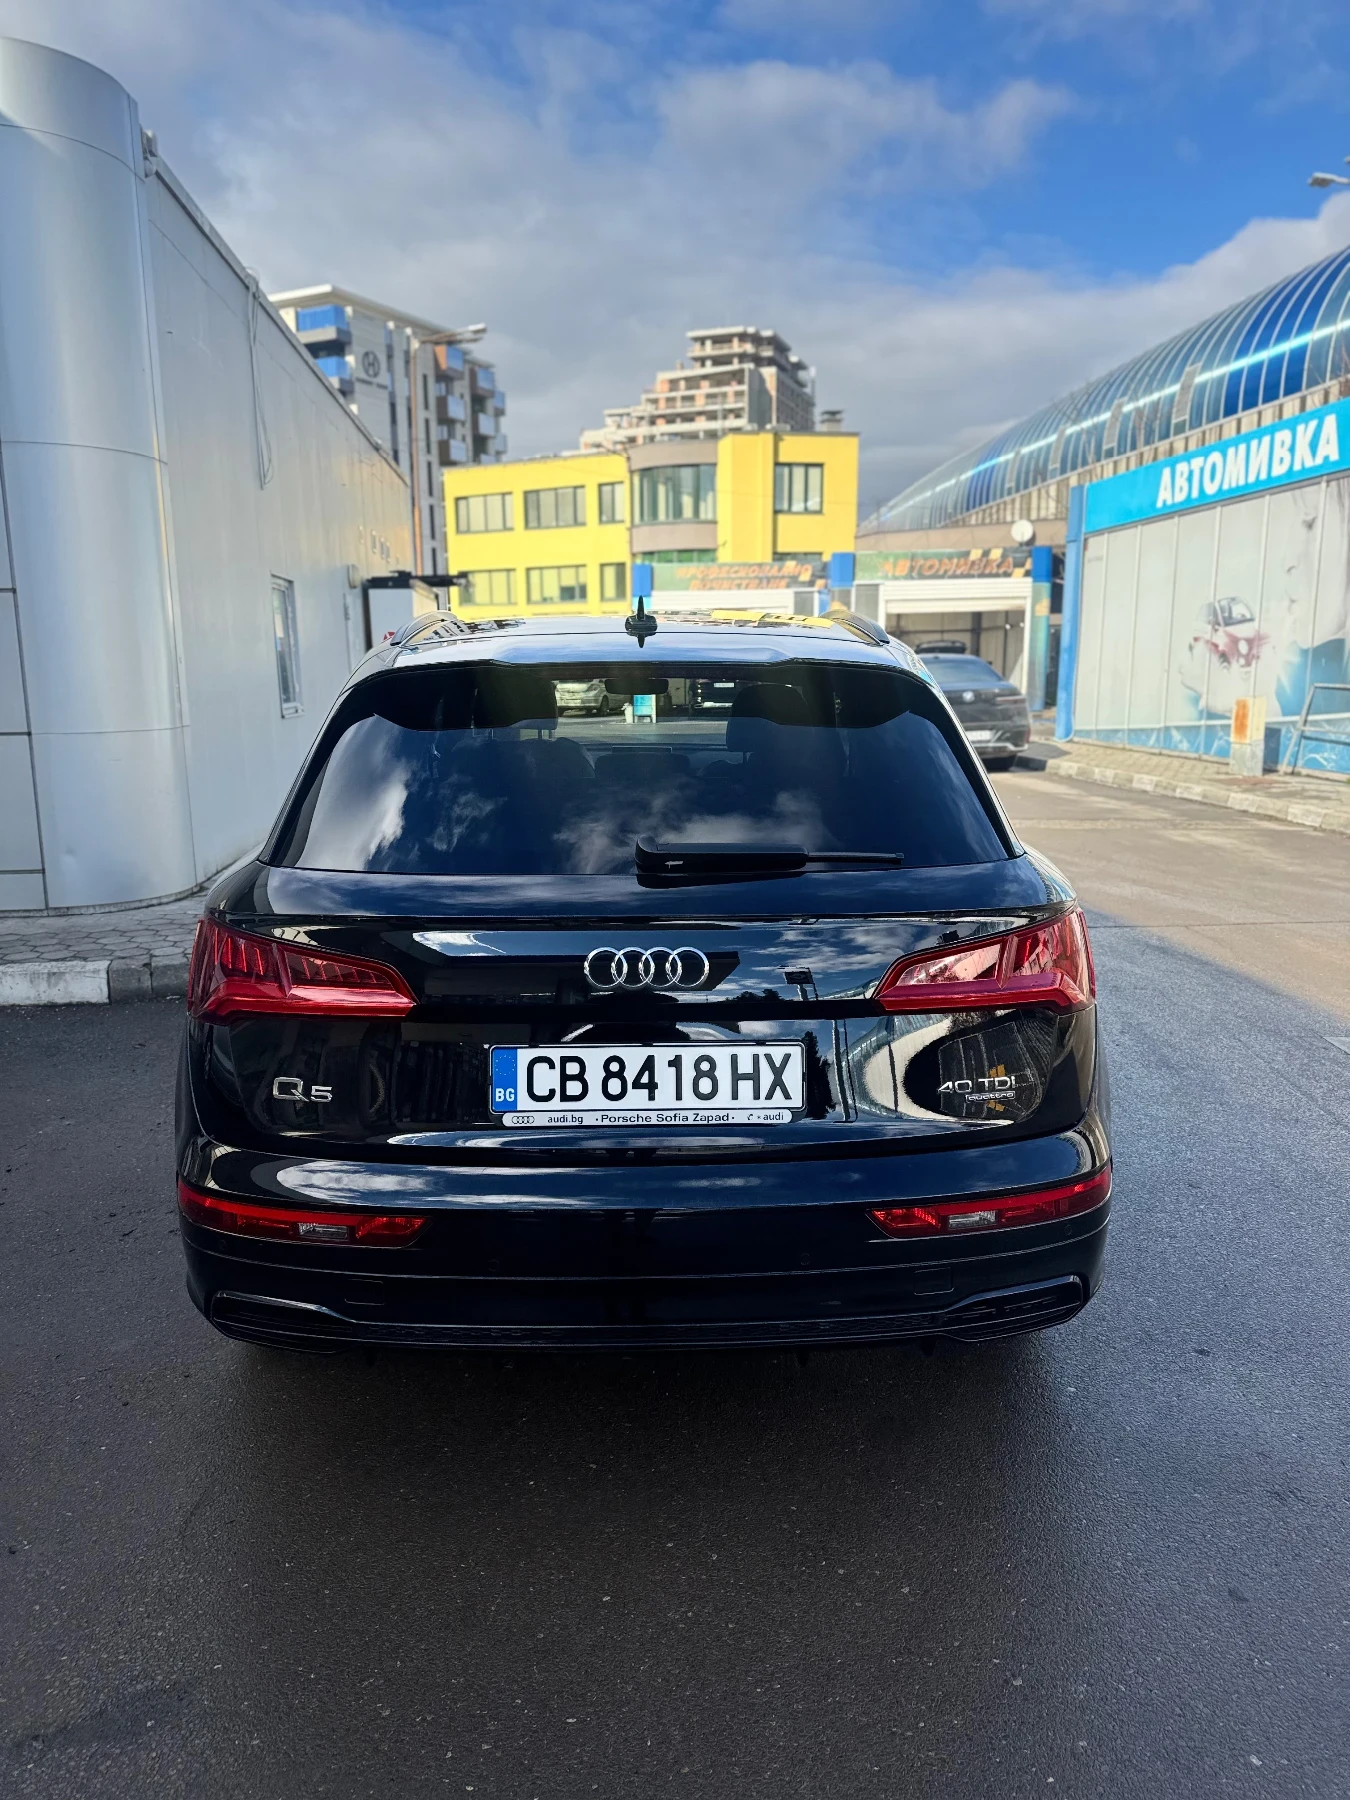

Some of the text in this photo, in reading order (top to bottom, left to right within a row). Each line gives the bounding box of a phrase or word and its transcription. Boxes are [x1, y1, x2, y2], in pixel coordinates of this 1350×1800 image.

[1156, 414, 1339, 508] АВТОМИВКА
[879, 557, 1013, 578] АВТОМИВКА
[527, 1053, 792, 1103] CB 8418 HX
[938, 1076, 1016, 1094] 40 TDI
[273, 1076, 332, 1103] Q5
[495, 1088, 515, 1102] BG
[968, 1092, 1014, 1101] quattro
[547, 1114, 583, 1125] audi.bg
[601, 1114, 652, 1123] Porsche
[656, 1112, 689, 1122] Sofia
[692, 1112, 729, 1124] Zapad
